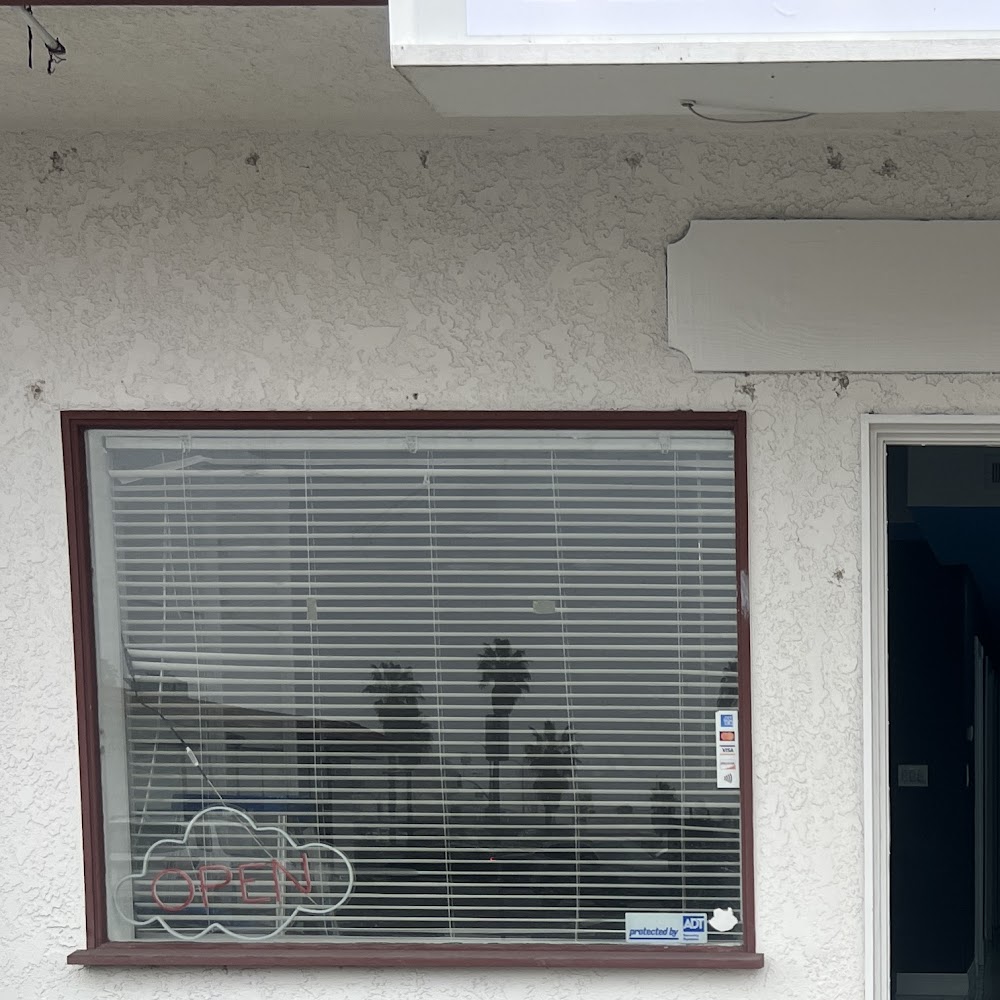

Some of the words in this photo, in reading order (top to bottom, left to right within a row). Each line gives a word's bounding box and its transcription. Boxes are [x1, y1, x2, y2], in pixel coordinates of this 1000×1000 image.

[151, 852, 311, 912] OPEN
[683, 918, 704, 929] ADT
[629, 927, 668, 937] protected
[668, 927, 679, 937] by
